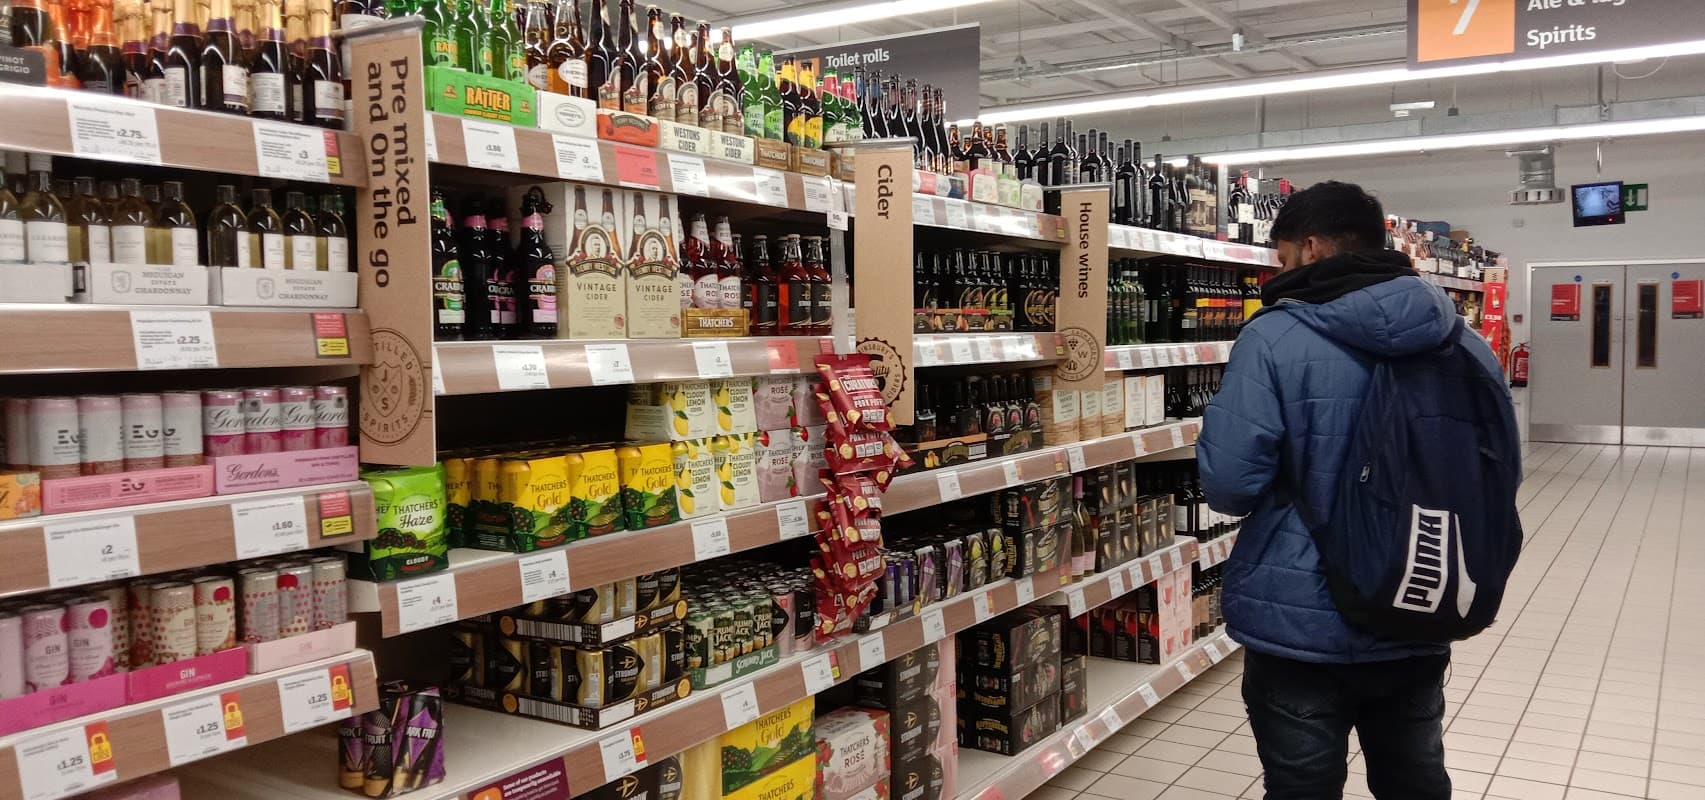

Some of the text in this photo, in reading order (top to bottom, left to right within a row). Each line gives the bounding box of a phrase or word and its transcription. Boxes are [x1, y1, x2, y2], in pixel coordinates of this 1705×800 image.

[1527, 24, 1597, 49] Spirits
[825, 48, 890, 68] Toilet rolls
[367, 62, 389, 124] and
[466, 85, 511, 113] RATTLER
[116, 128, 142, 139] £2.75
[673, 126, 701, 142] WESTONS
[391, 56, 417, 228] Pre mixed
[678, 140, 697, 153] CIDER
[299, 149, 309, 159] £3
[724, 147, 742, 160] CIDER
[877, 163, 893, 220] Cider
[373, 186, 392, 239] the
[1077, 202, 1093, 298] House wines
[369, 249, 390, 288] go
[576, 282, 617, 293] VINTAGE
[635, 284, 673, 294] VINTAGE
[586, 293, 609, 301] CIDER
[643, 294, 665, 302] CIDER
[698, 317, 735, 329] THATCHERS
[176, 335, 200, 345] £2.25
[374, 341, 414, 371] TILLED
[1078, 351, 1088, 359] W
[872, 363, 890, 379] lity
[886, 373, 901, 399] CIDERS
[686, 397, 706, 407] LEMON
[730, 395, 749, 403] LEMON
[363, 411, 409, 433] SPIRITS
[688, 457, 714, 469] THATCHERS
[729, 451, 756, 462] THATCHERS
[583, 471, 617, 484] THATCHERS
[641, 463, 672, 477] THATCHERS
[733, 470, 752, 478] LEMON
[531, 479, 568, 494] THATCHERS
[646, 475, 667, 490] Gold
[692, 475, 711, 485] LEMON
[588, 481, 612, 500] Gold
[393, 498, 440, 516] THATCHERS
[536, 490, 563, 509] Gold
[400, 513, 433, 529] Haze
[101, 544, 113, 555] £2
[1401, 512, 1442, 608] PUMA
[45, 645, 60, 655] GIN
[73, 638, 90, 647] GIN
[760, 648, 776, 666] JACK
[179, 667, 196, 680] GIN
[307, 693, 328, 705] £1.25
[755, 707, 792, 731] THATCHERS
[196, 722, 219, 735] £1.25
[406, 726, 437, 739] ARK FRU
[760, 723, 784, 745] Gold
[839, 736, 871, 757] THATCHERS
[56, 755, 84, 771] £1.25
[844, 749, 866, 768] ROSÉ
[758, 778, 795, 800] THATCHERS
